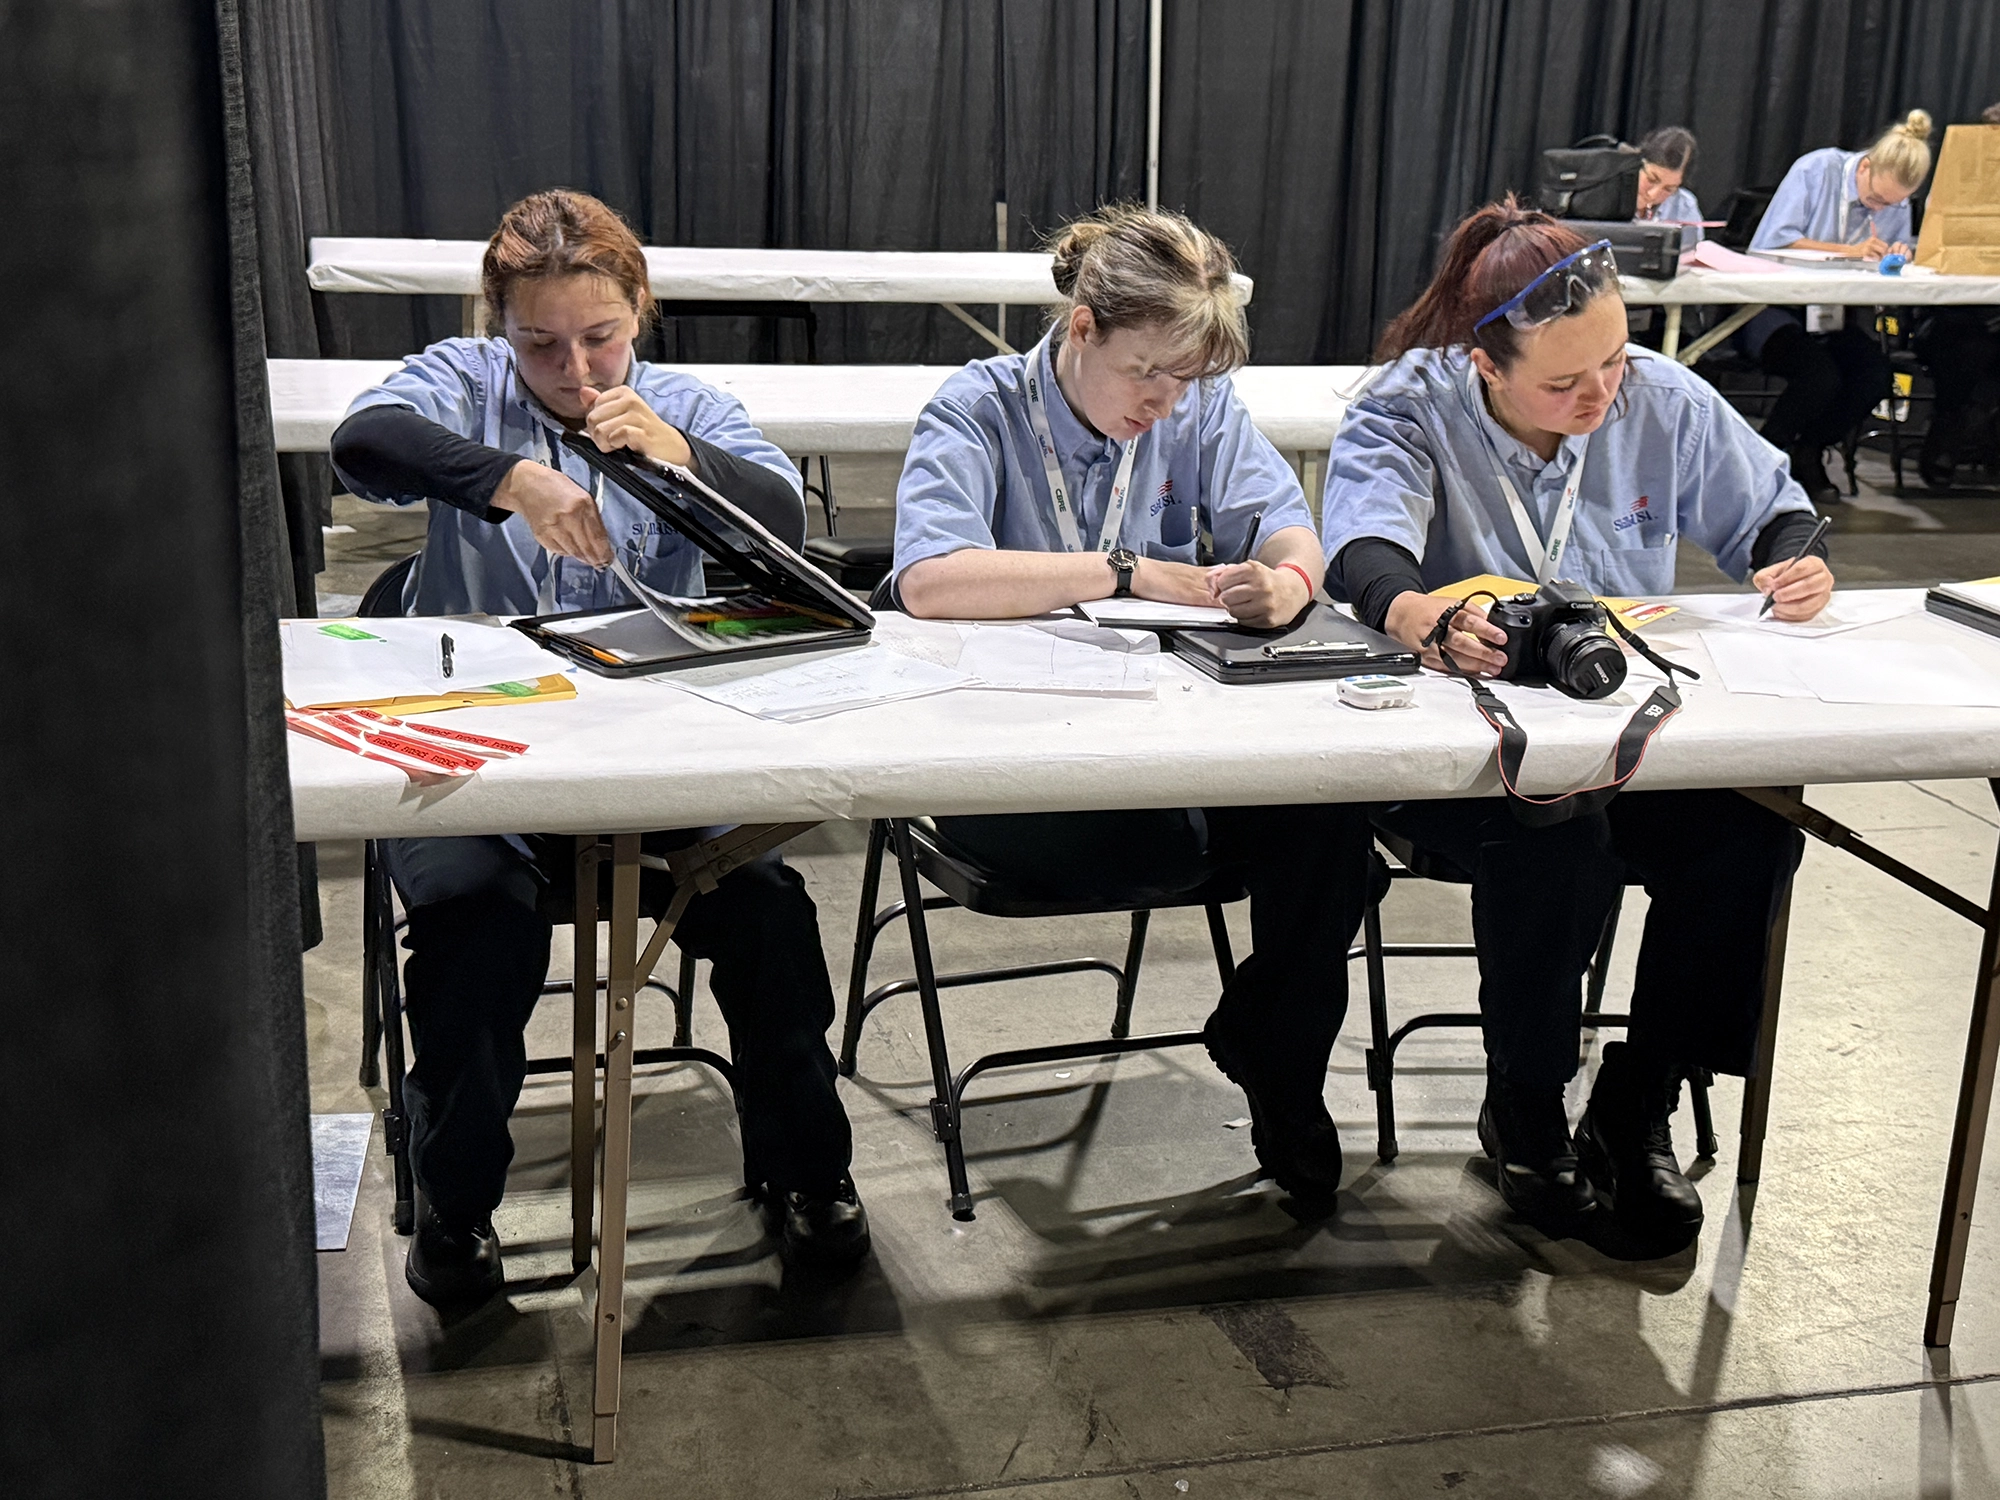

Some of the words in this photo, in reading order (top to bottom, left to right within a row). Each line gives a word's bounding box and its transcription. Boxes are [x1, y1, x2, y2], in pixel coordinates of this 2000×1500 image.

[1029, 377, 1039, 403] CBRE
[1055, 488, 1067, 513] CBRE
[1549, 538, 1561, 562] CBRE
[1570, 601, 1594, 610] Canon
[1594, 662, 1610, 684] Canon
